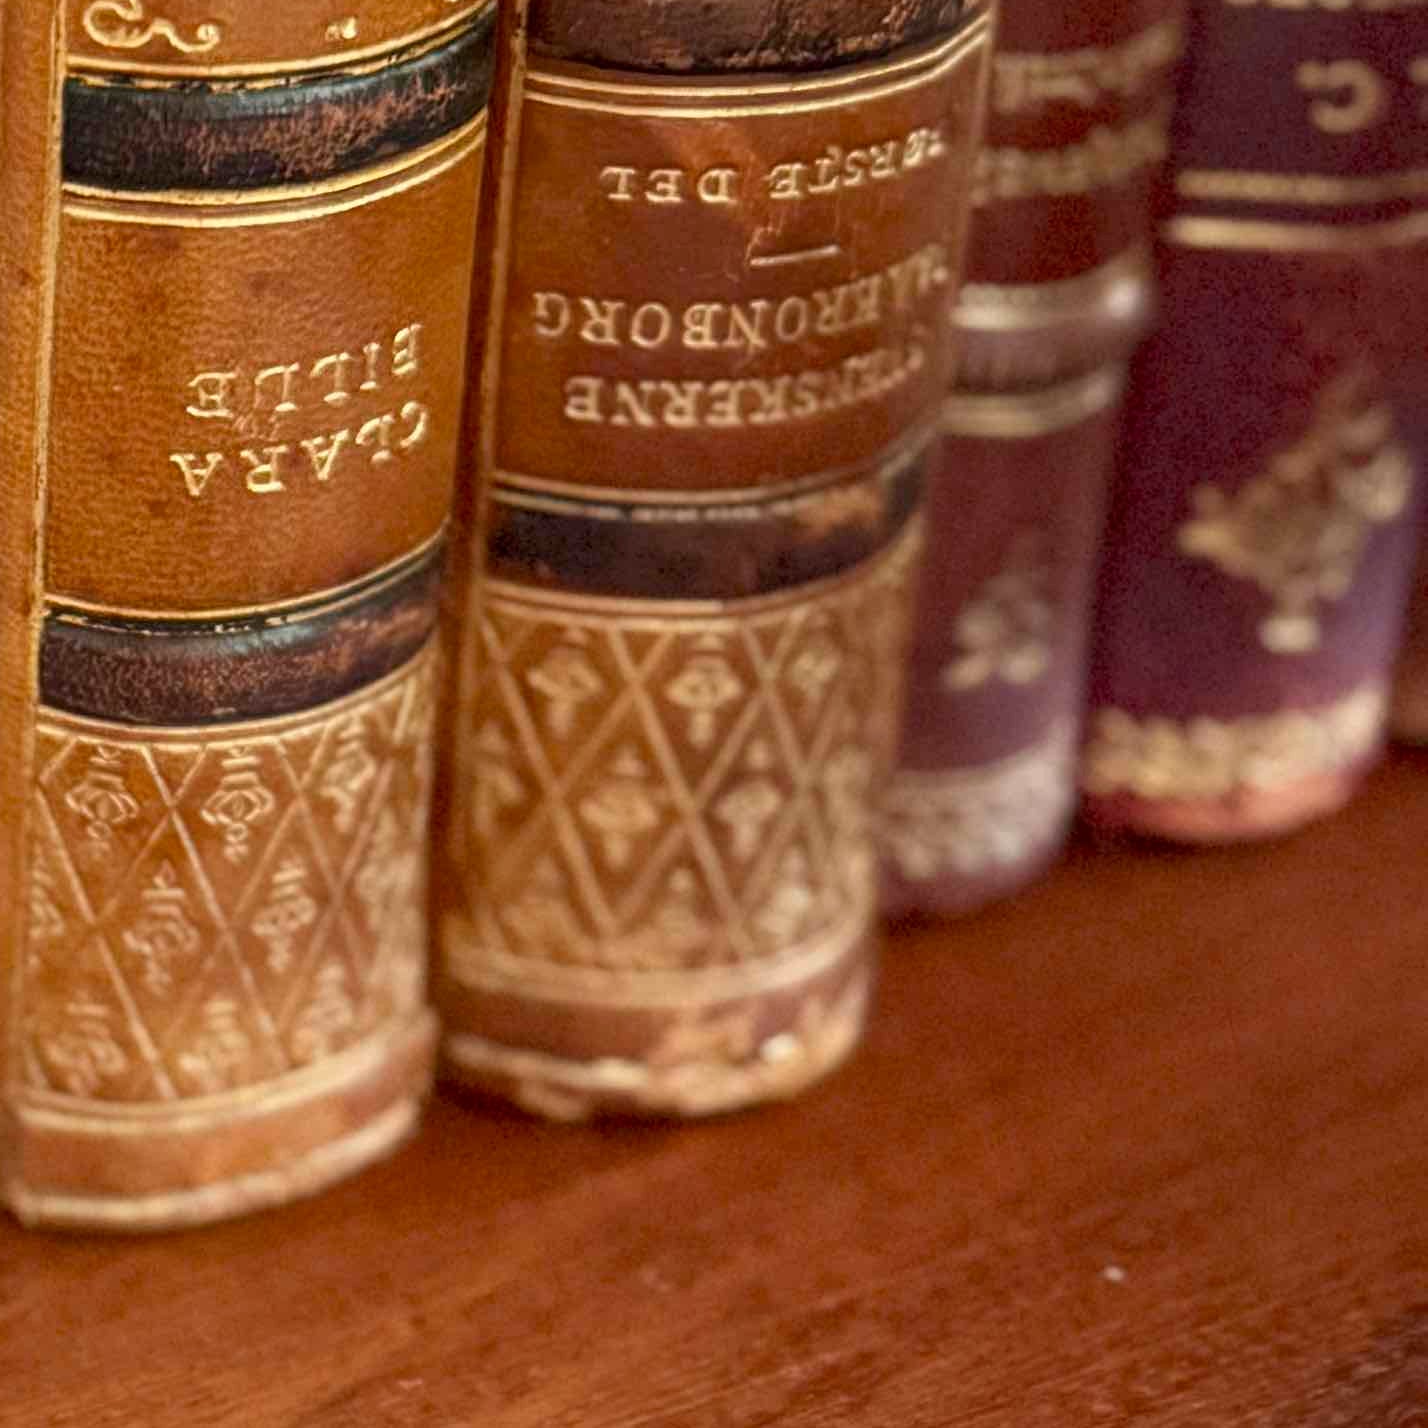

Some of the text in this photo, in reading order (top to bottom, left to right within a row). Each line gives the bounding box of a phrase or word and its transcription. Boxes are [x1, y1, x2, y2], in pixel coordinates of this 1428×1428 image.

[600, 165, 736, 204] DEL
[186, 324, 423, 419] BILLE
[170, 400, 428, 497] CLARA
